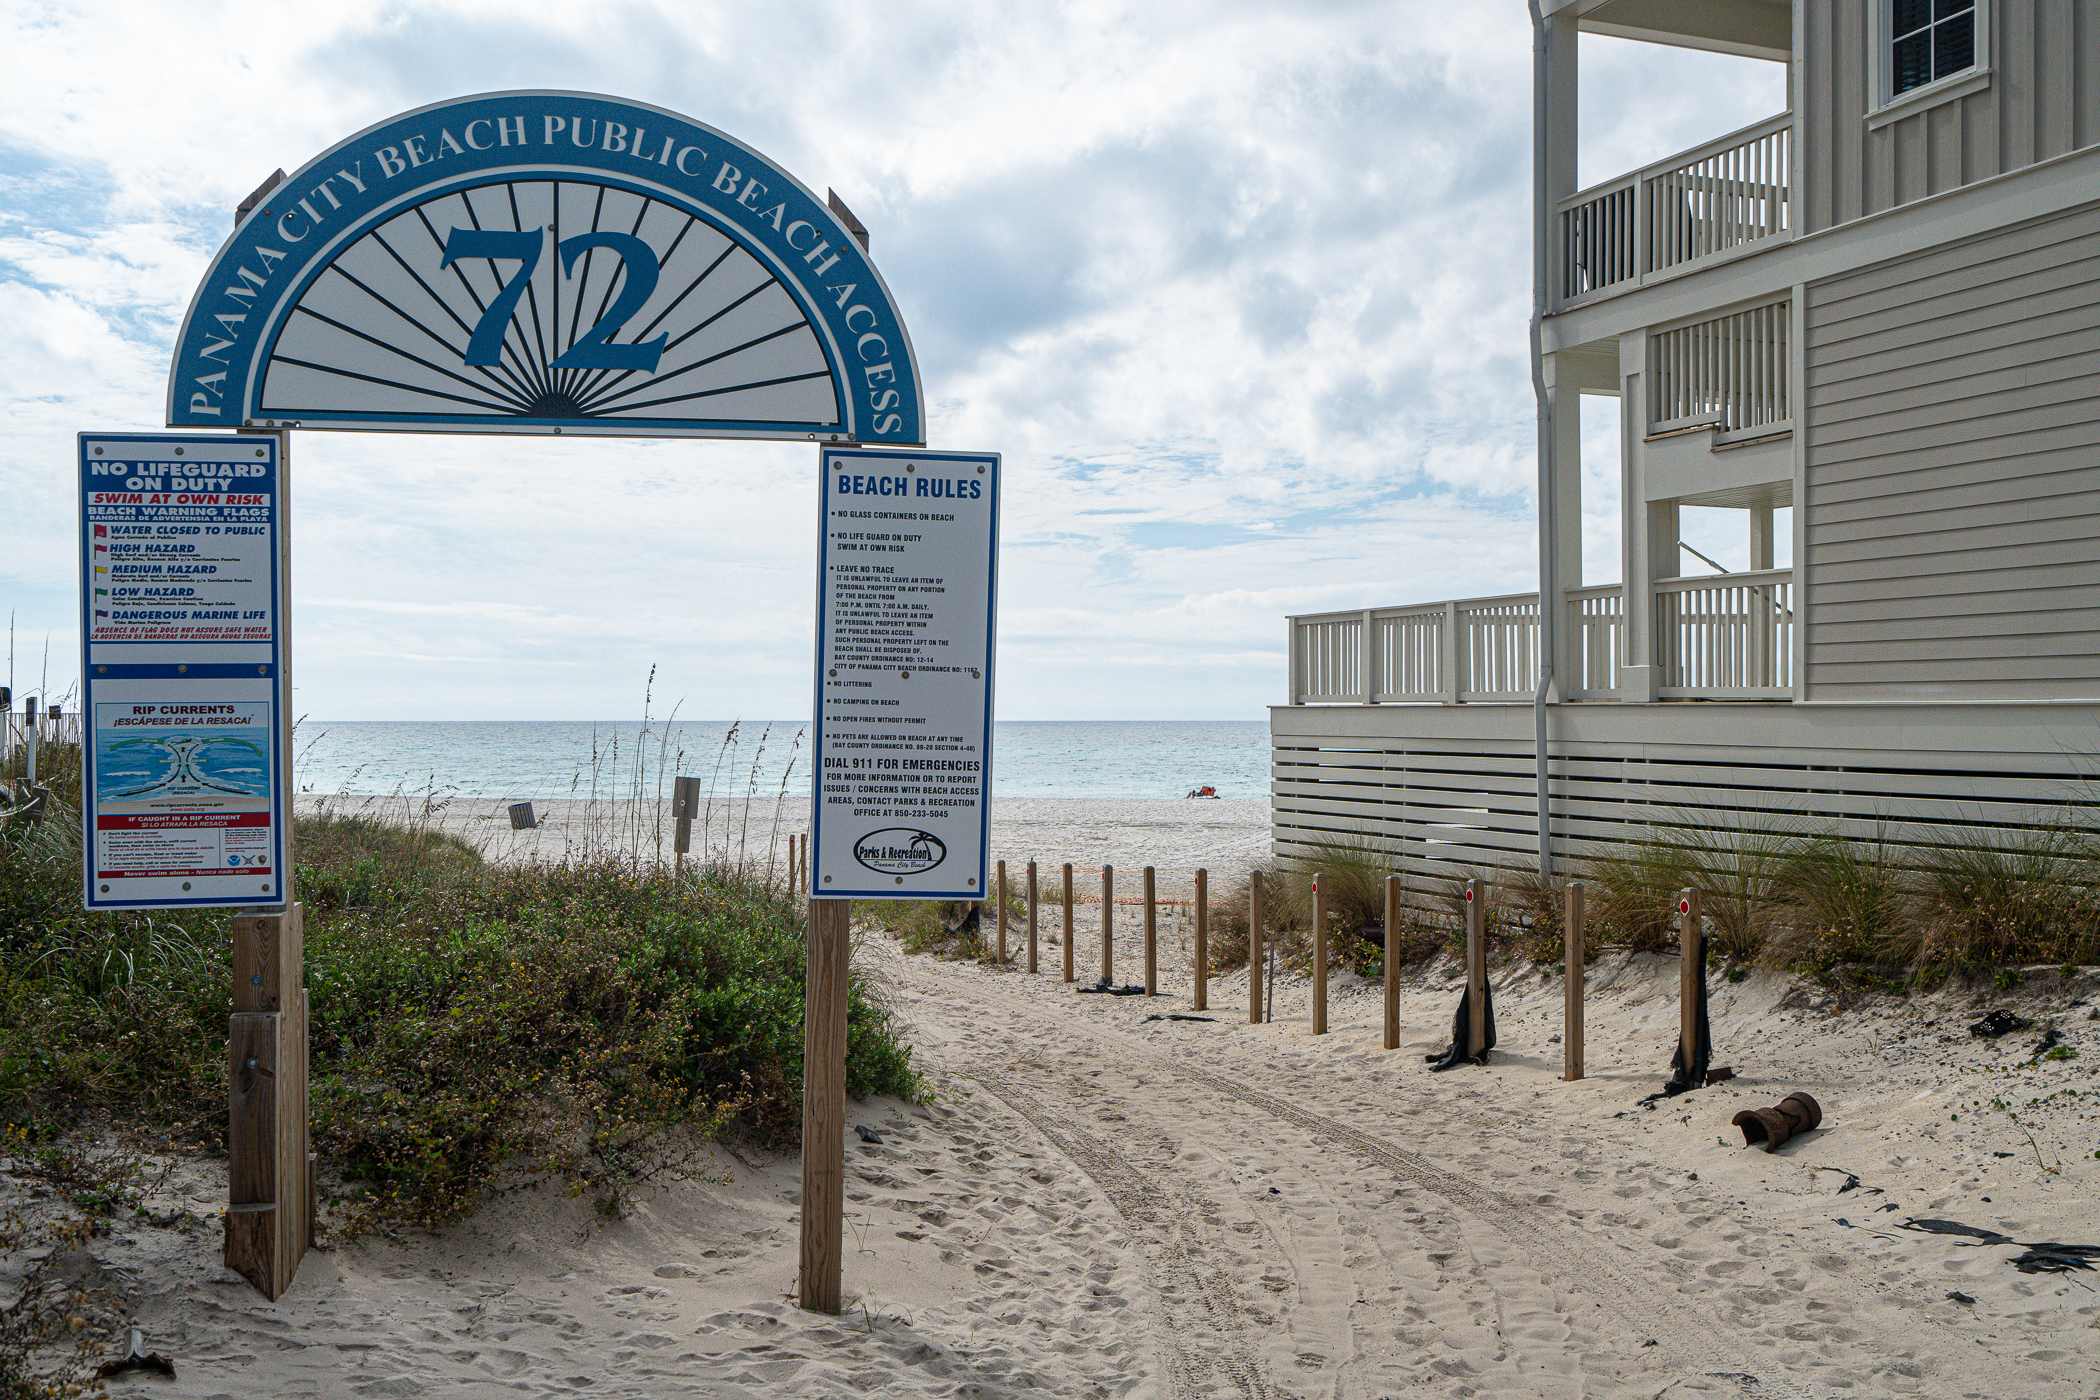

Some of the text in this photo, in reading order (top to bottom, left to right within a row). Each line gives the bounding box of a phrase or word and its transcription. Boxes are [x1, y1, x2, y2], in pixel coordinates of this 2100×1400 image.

[190, 114, 904, 434] PANAMA CITY BEACH PUBLIC BEACH ACCESS
[440, 224, 670, 375] 72
[91, 462, 266, 477] NO LIFEGUARD
[125, 477, 233, 491] ON DUTY
[838, 476, 982, 499] BEACH RULES
[94, 493, 264, 505] SWIM AT OWN RISK
[88, 506, 270, 516] BEACH WARNING FLAGS
[111, 526, 266, 535] WATER CLOSED TO PUBLIC
[112, 611, 266, 619] DANGEROUS MARINE LIFE
[133, 706, 235, 714] RIP CURRENTS
[174, 717, 188, 726] DE
[190, 717, 204, 725] LA
[824, 758, 980, 771] DIAL 911 FOR EMERGENCIES
[860, 847, 927, 859] Parks & Recreation
